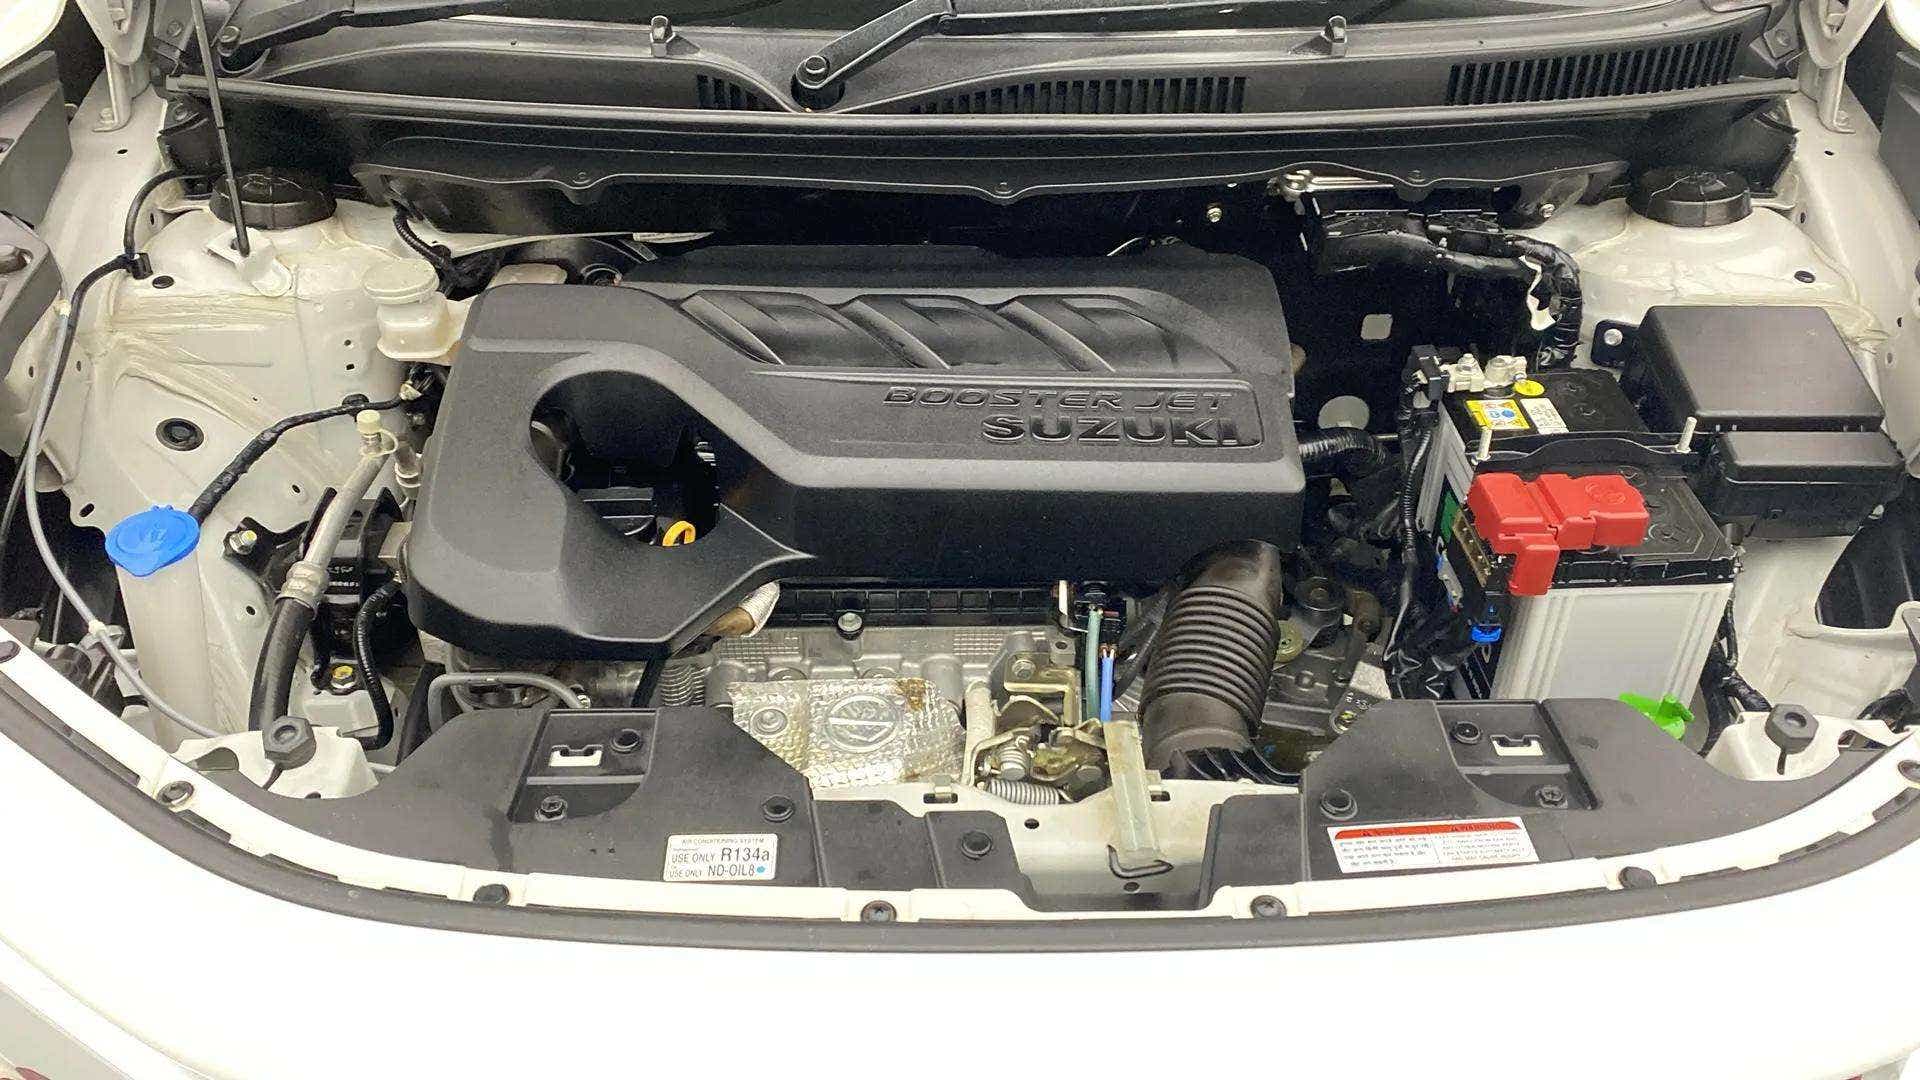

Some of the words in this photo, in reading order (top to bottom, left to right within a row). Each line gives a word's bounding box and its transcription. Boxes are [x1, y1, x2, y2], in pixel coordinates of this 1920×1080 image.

[882, 386, 1122, 410] BOOSTER
[1133, 391, 1236, 410] JET
[982, 415, 1241, 446] SUZUKI
[671, 853, 689, 863] USE
[692, 852, 715, 863] ONLY
[721, 847, 770, 862] R134a
[669, 870, 684, 878] USE
[685, 869, 702, 877] ONLY
[707, 863, 755, 877] ND-OIL8
